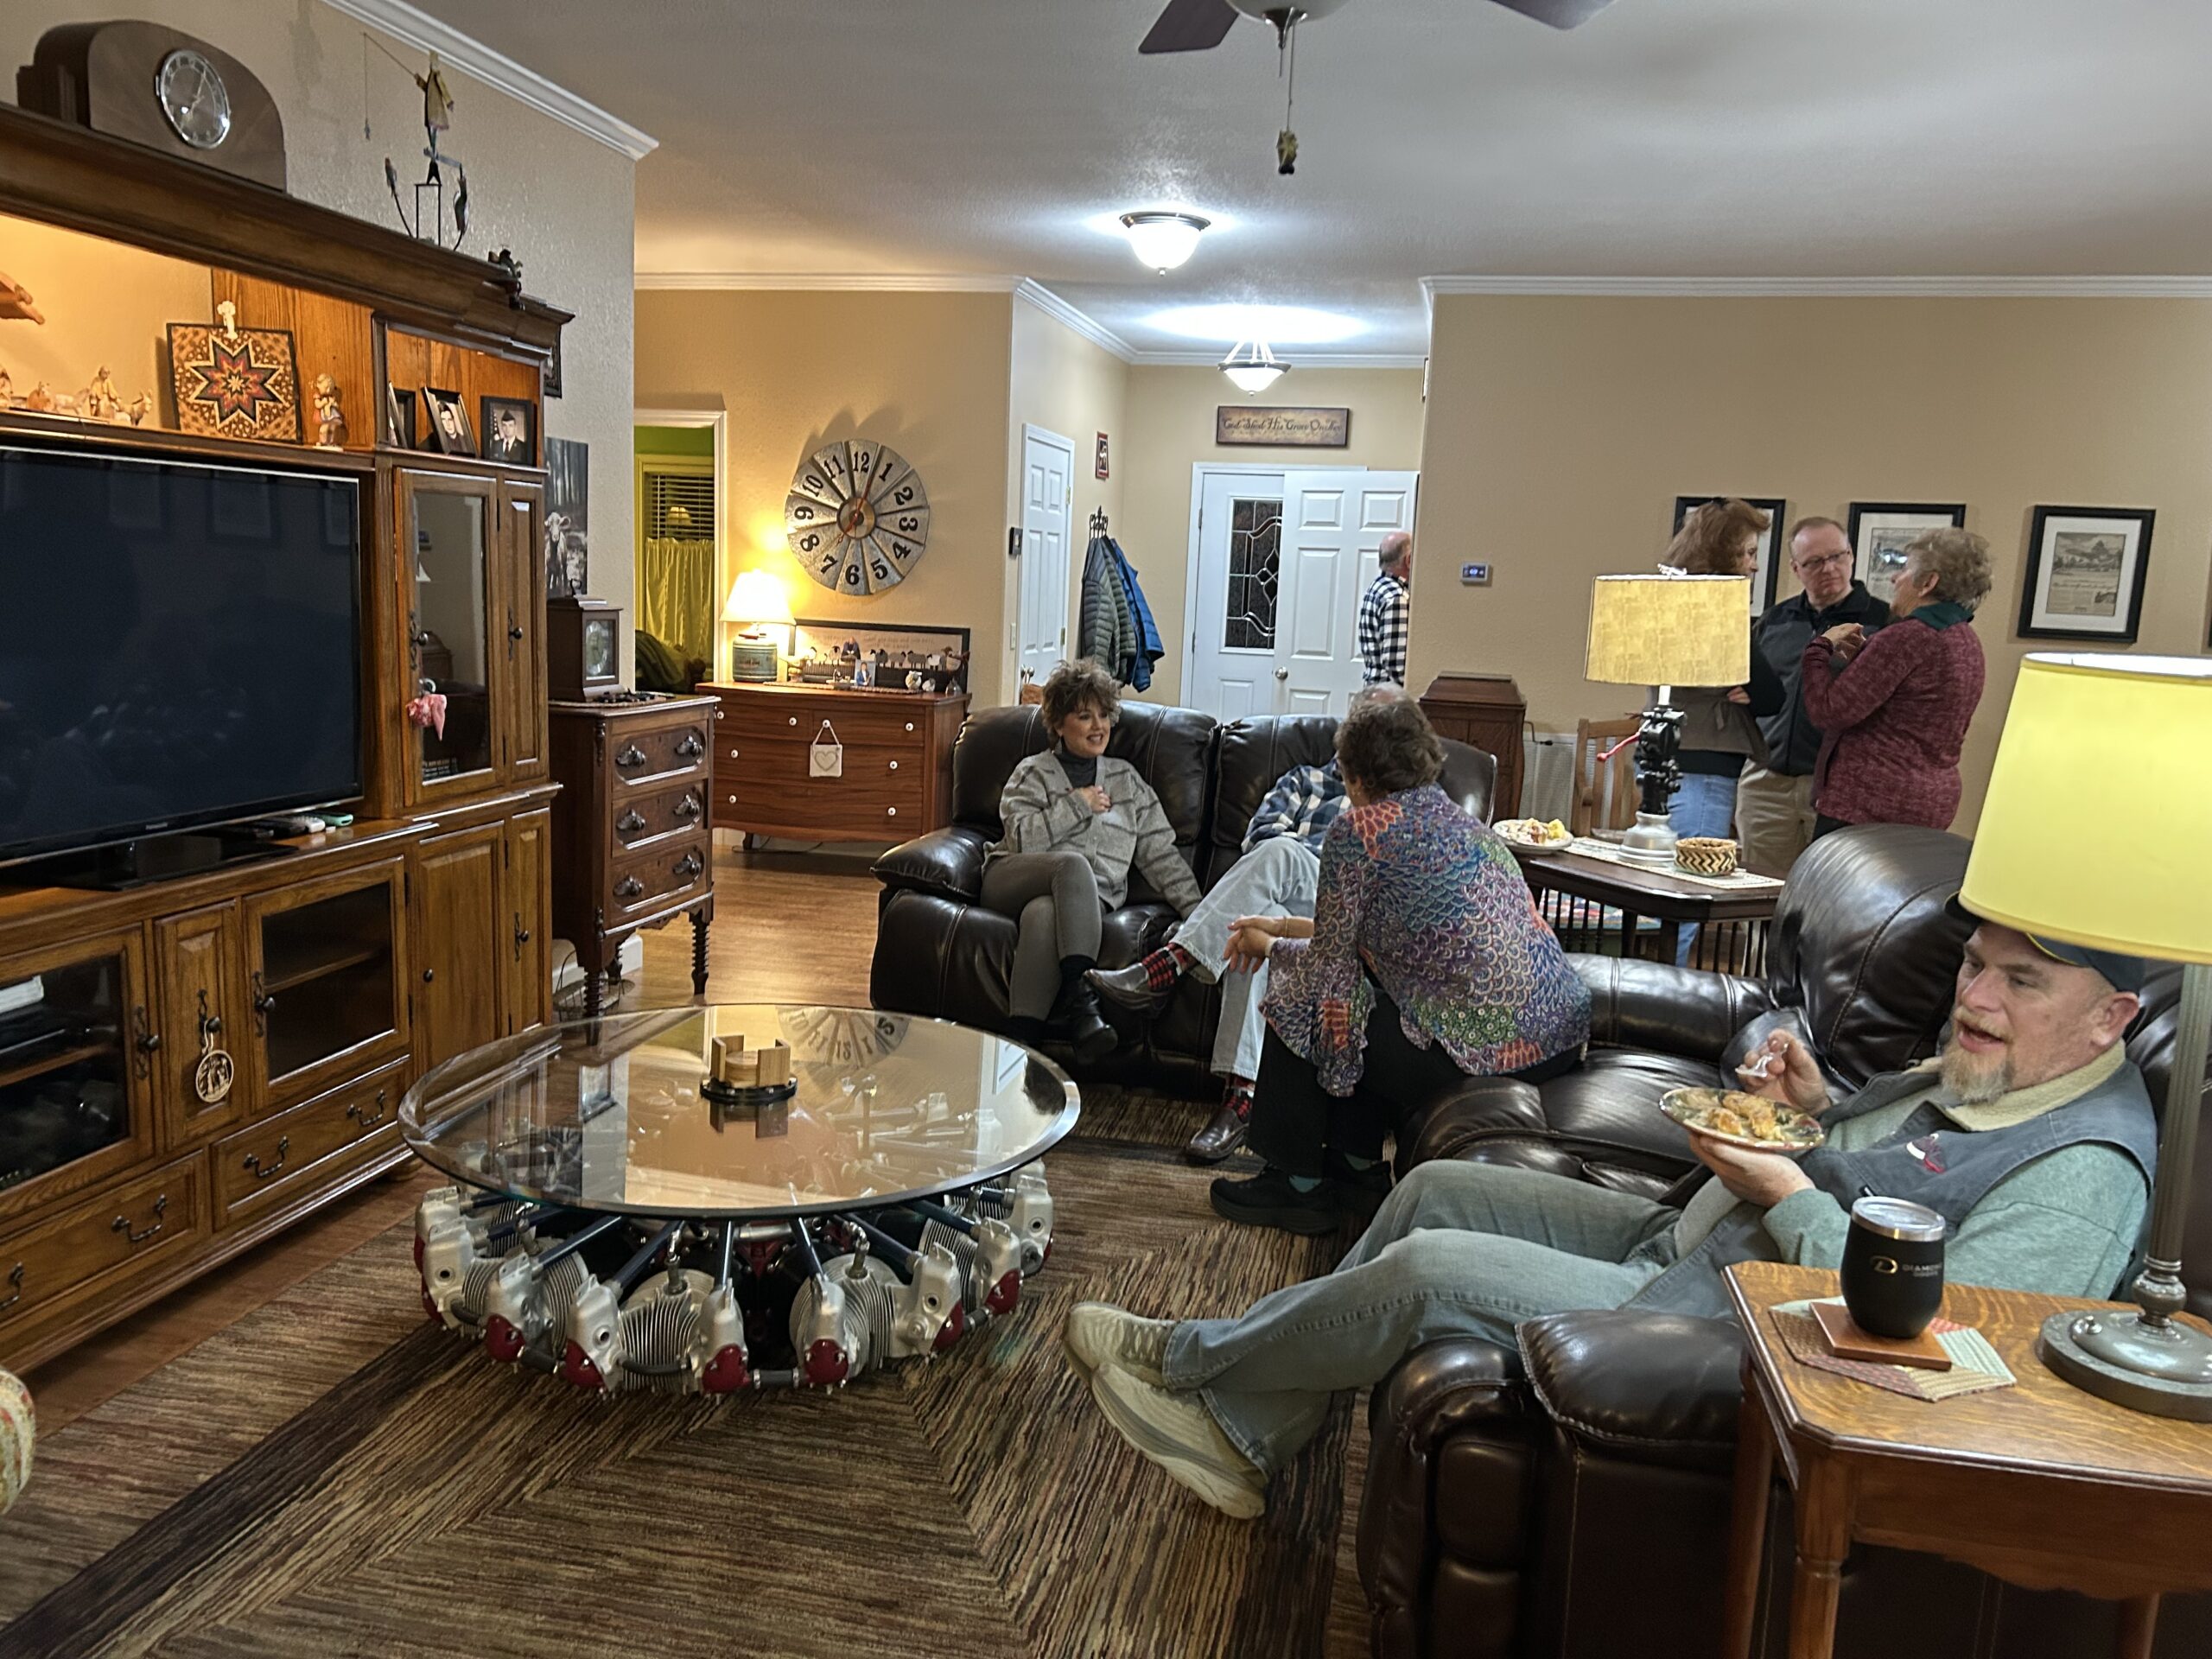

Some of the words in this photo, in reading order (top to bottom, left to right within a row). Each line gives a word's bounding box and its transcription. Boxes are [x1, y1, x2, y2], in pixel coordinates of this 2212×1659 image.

[824, 455, 845, 479] 11
[854, 452, 870, 473] 12
[879, 462, 893, 481] 1
[802, 474, 823, 497] 10
[893, 486, 913, 505] 2
[794, 506, 814, 520] 9
[899, 517, 918, 531] 3
[800, 534, 820, 551] 8
[892, 541, 911, 560] 4
[821, 554, 837, 574] 7
[870, 559, 888, 580] 5
[845, 564, 860, 585] 6
